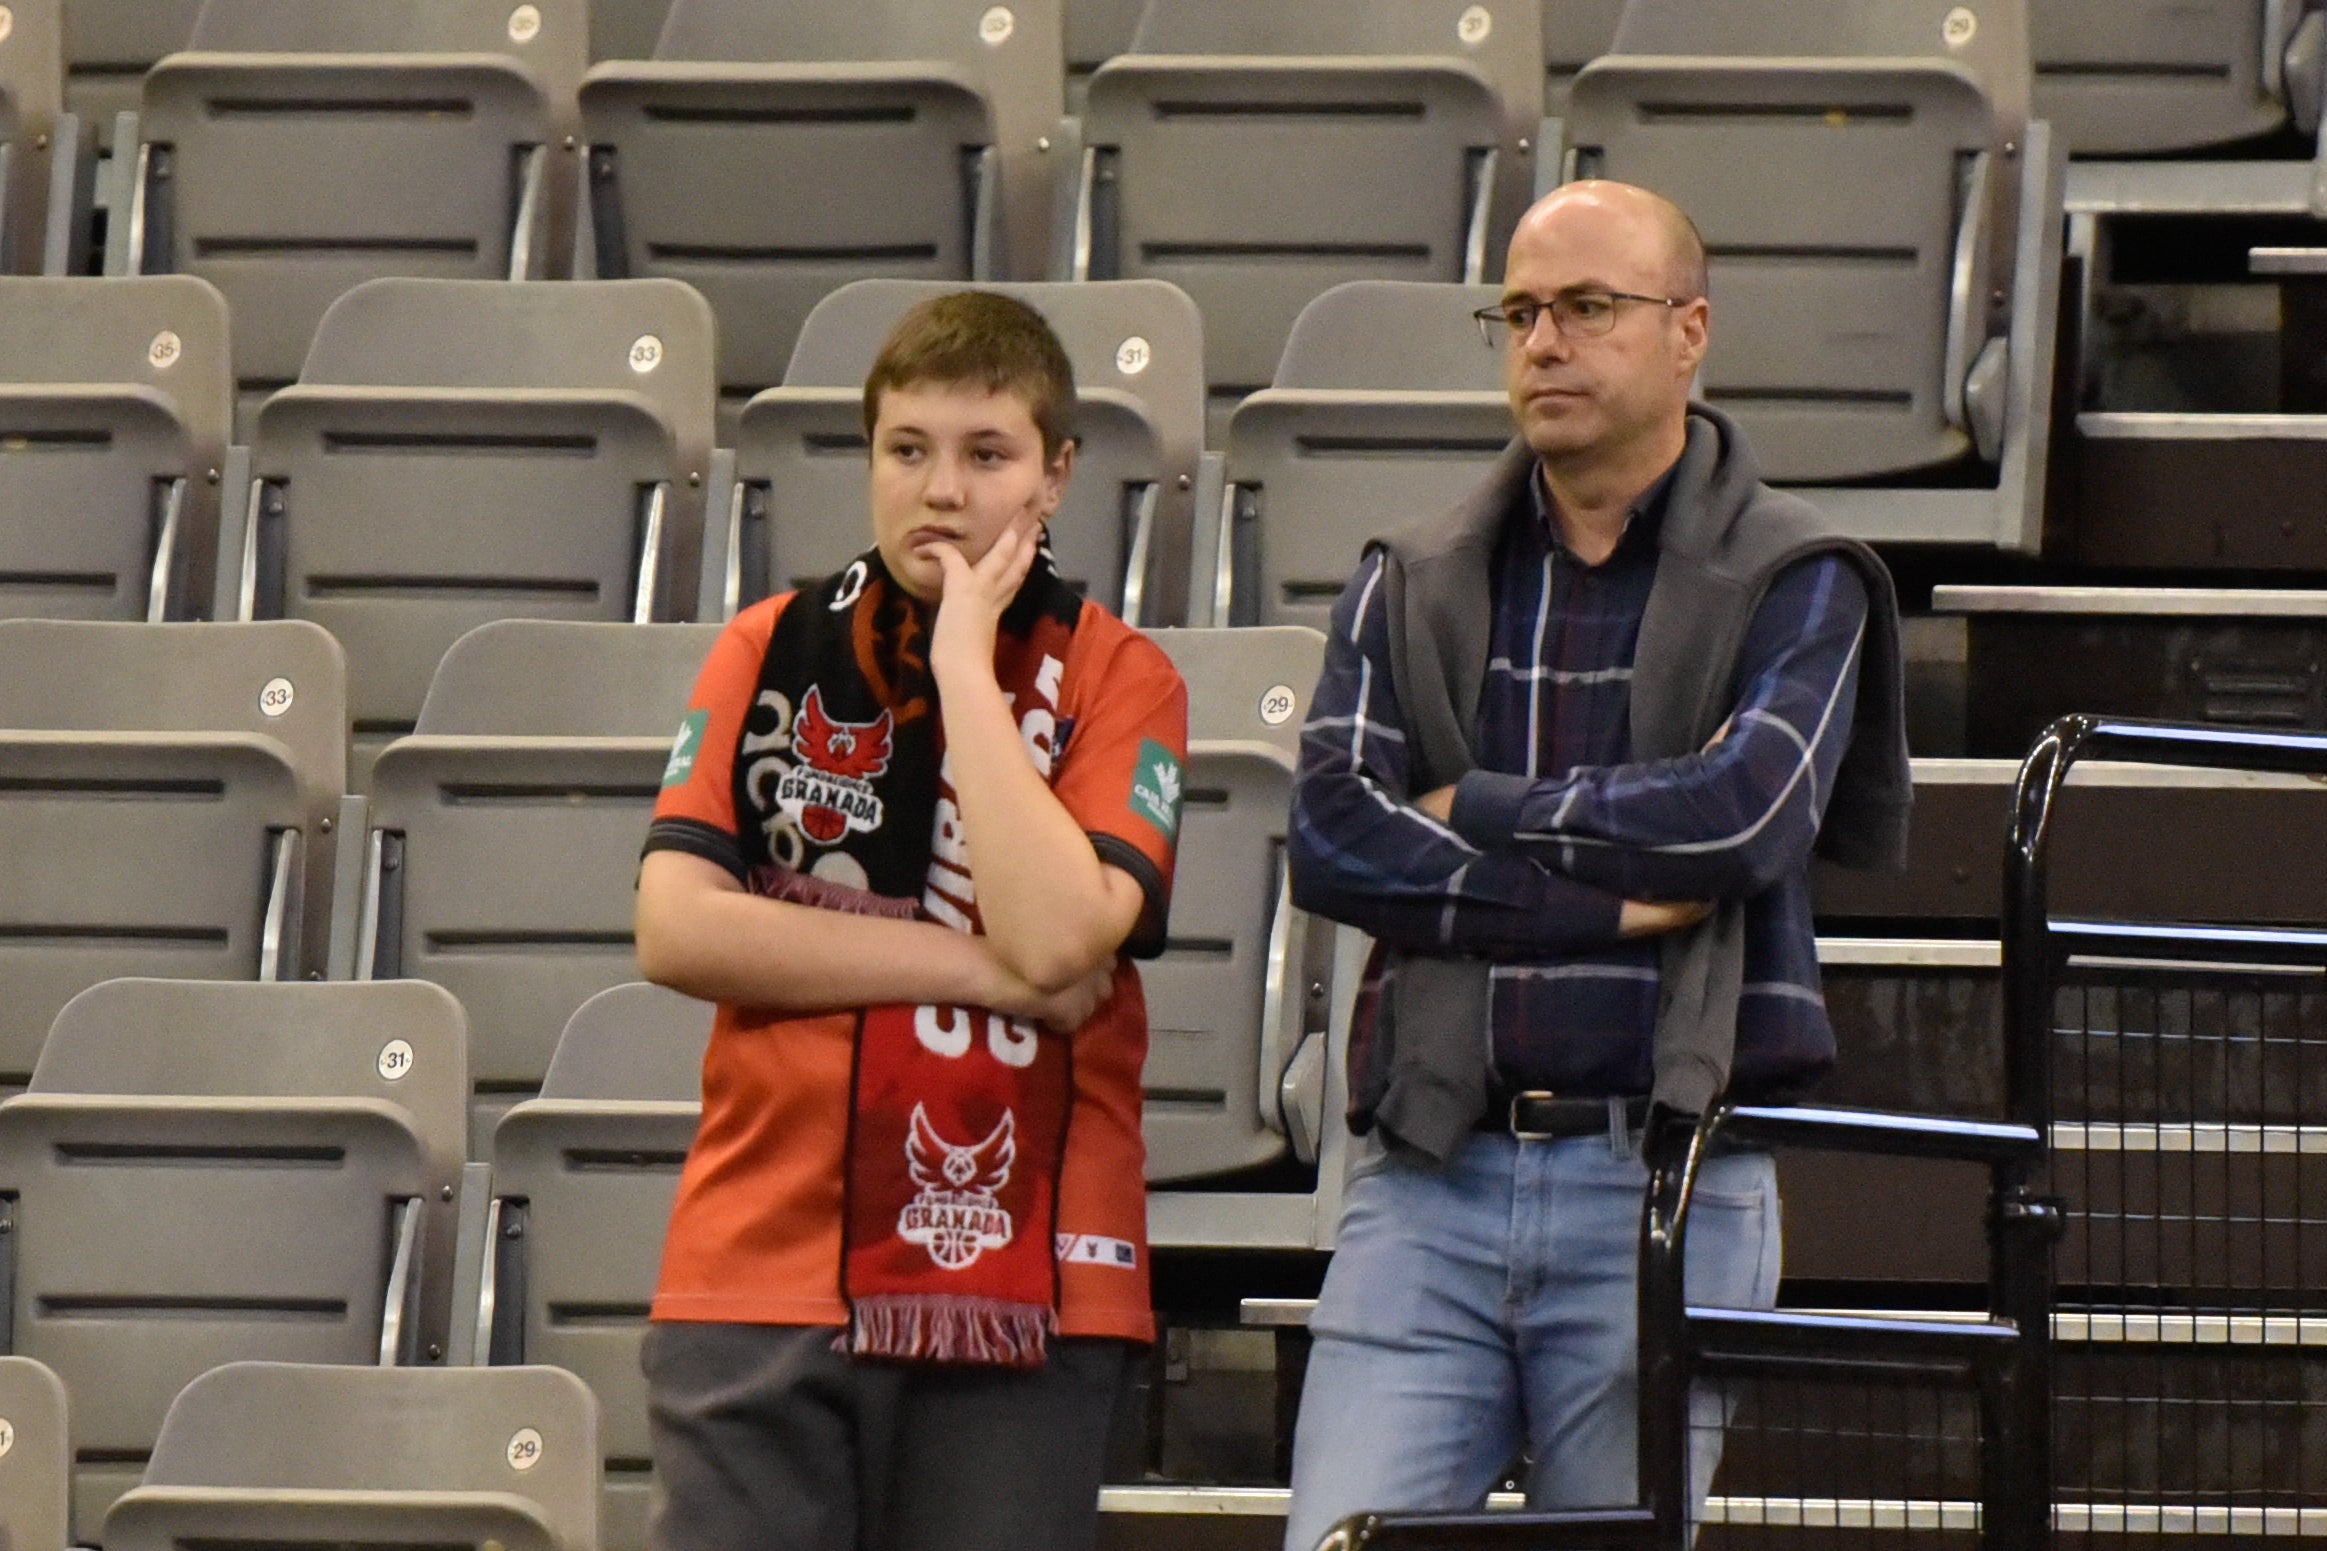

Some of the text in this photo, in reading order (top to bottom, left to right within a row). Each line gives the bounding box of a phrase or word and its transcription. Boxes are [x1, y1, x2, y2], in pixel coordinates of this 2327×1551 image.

[152, 341, 174, 360] 35
[634, 345, 656, 362] 33
[1125, 346, 1144, 364] 31
[265, 689, 288, 707] 33
[1267, 696, 1290, 715] 29
[781, 777, 878, 825] GRANADA
[387, 1052, 406, 1070] 31
[905, 1207, 1006, 1239] GRANADA
[514, 1440, 536, 1460] 29
